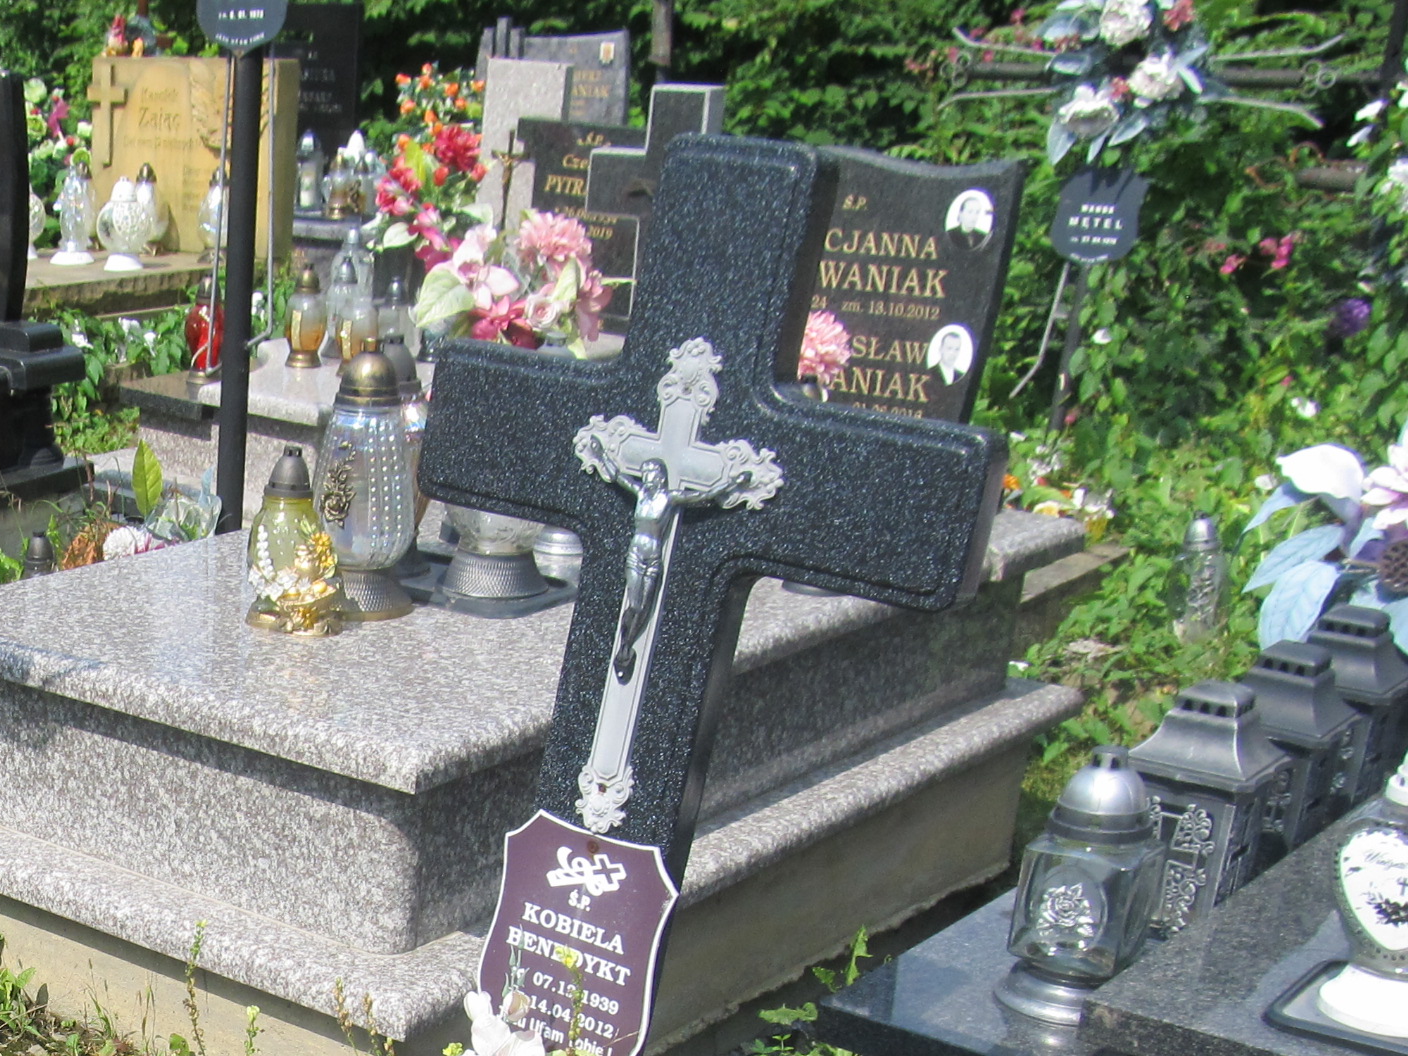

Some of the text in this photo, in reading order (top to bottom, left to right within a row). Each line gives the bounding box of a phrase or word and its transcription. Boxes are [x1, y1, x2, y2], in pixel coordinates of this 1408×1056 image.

[561, 153, 589, 170] Cze
[543, 174, 589, 196] PYTR
[824, 227, 939, 260] CJANNA
[819, 259, 949, 299] WANIAK
[811, 294, 941, 321] 24 zm. 13.10.2012
[852, 335, 930, 365] SŁAW
[829, 367, 932, 404] ANIAK
[568, 889, 591, 912] Ś.P.
[522, 902, 625, 955] KOBIELA
[533, 971, 619, 1015] 07.121939
[530, 995, 614, 1039] 14.042012
